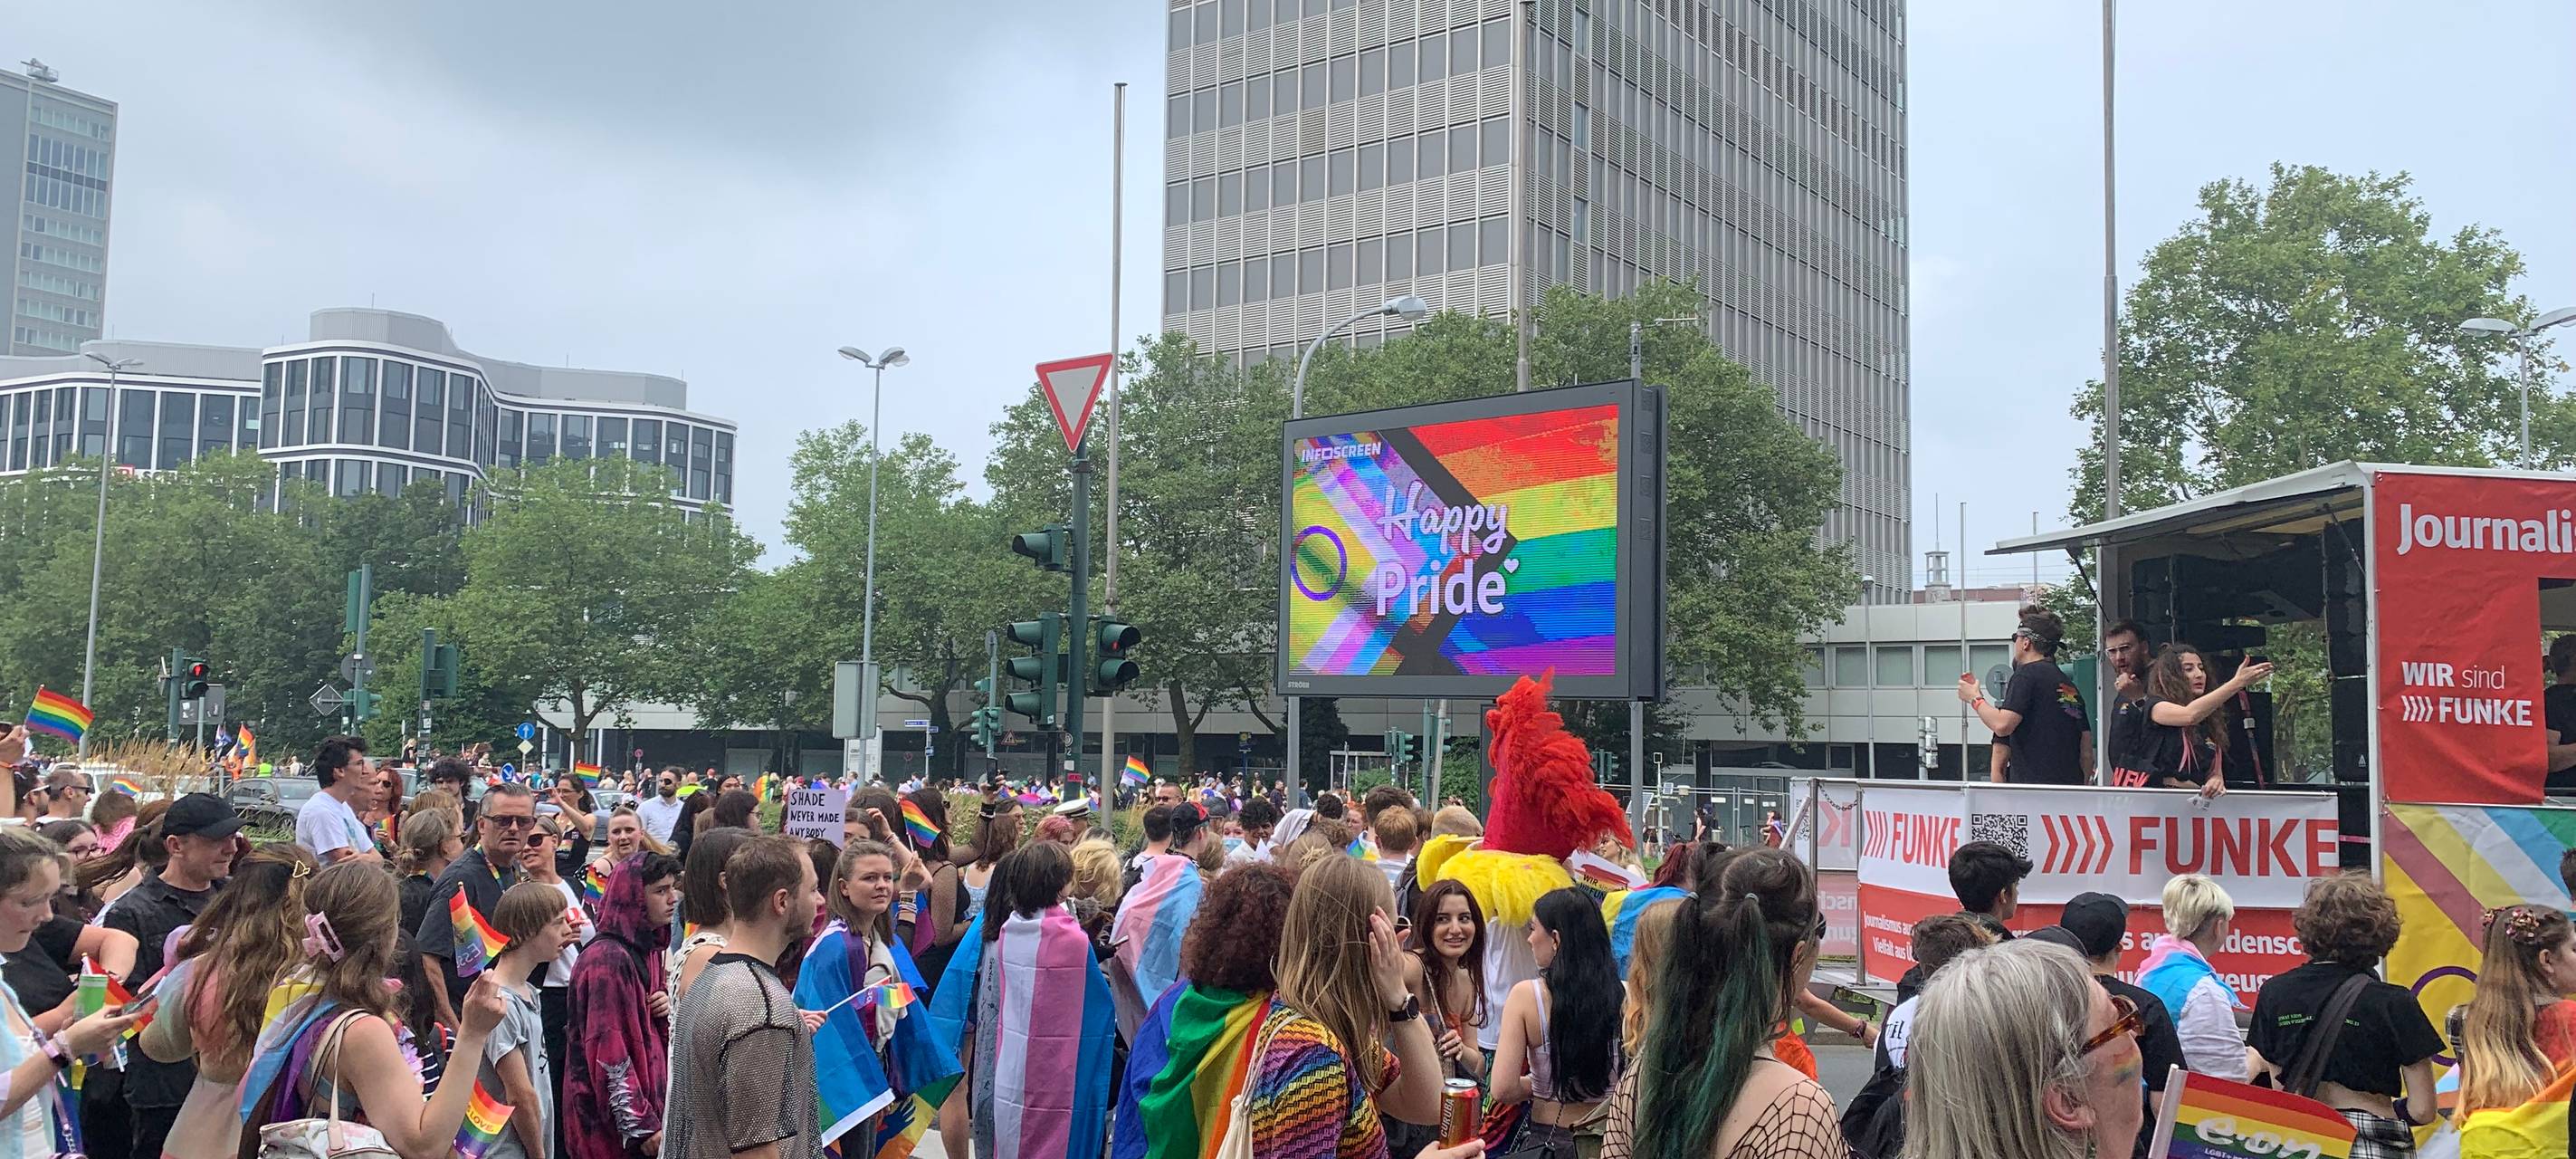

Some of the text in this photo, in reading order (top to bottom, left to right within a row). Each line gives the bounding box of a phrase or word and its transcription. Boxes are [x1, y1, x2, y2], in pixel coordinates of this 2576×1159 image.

[1302, 442, 1382, 463] INFOSCREEN
[1376, 481, 1507, 554] Happy
[2397, 503, 2576, 555] Journali
[1376, 559, 1506, 616] Pride
[2401, 662, 2505, 689] WIR sind
[2439, 696, 2533, 726] FUNKE
[790, 791, 825, 807] SHADE
[790, 810, 840, 823] NEVER MADE
[1890, 812, 1961, 868] FUNKE
[2129, 816, 2340, 876] FUNKE
[1583, 874, 1598, 886] WIR
[1440, 1098, 1455, 1138] CURUBA
